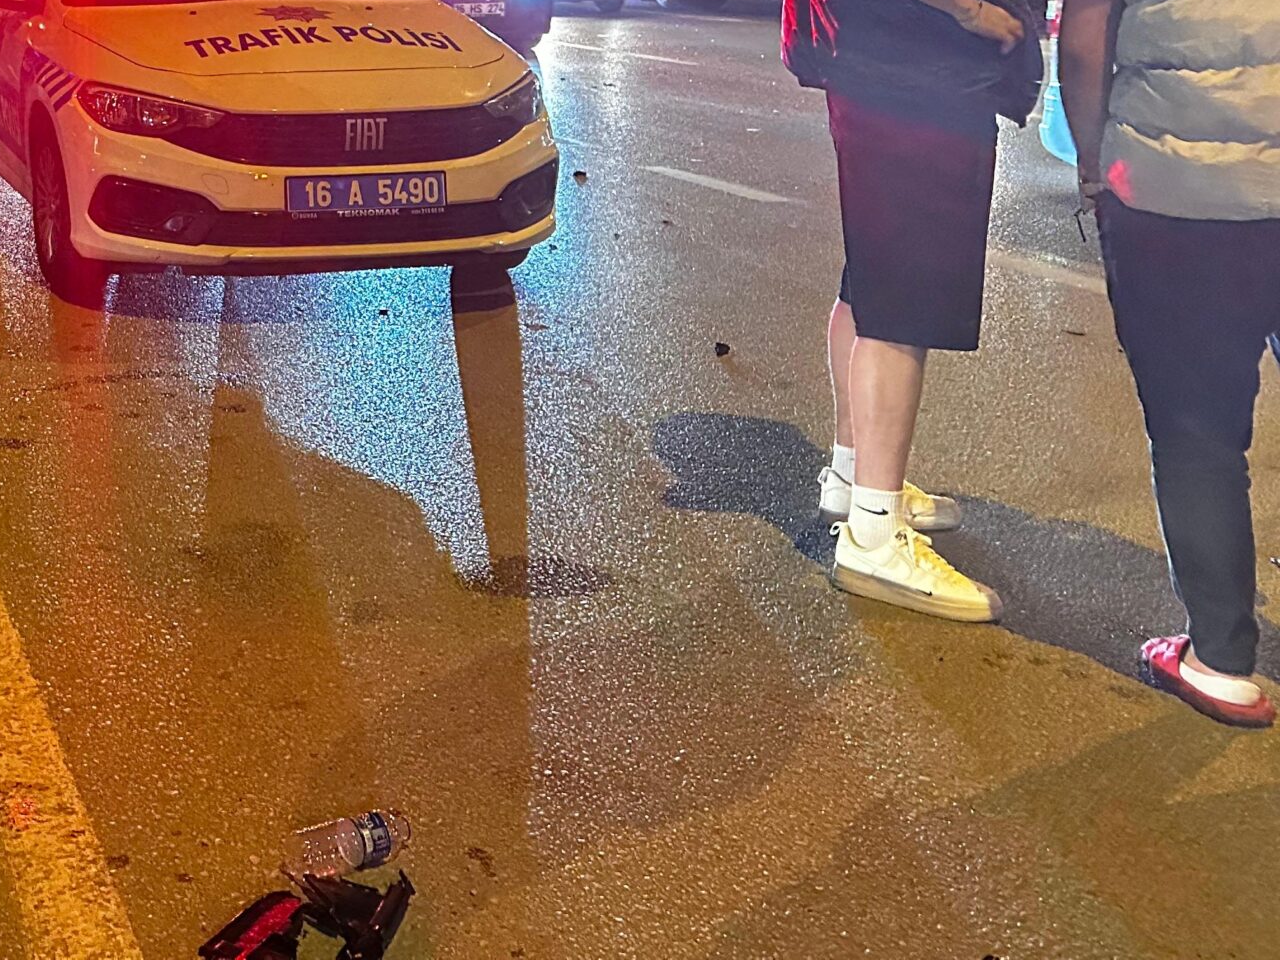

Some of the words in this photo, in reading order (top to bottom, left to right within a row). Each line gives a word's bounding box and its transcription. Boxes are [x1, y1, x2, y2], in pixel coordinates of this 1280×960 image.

[470, 4, 483, 13] HS
[184, 25, 331, 58] TRAFİK
[332, 25, 463, 52] POLİSİ
[345, 118, 388, 151] FIAT
[305, 180, 332, 207] 16
[348, 179, 364, 206] A
[378, 176, 439, 205] 5490
[337, 208, 400, 218] TEKNOMAK
